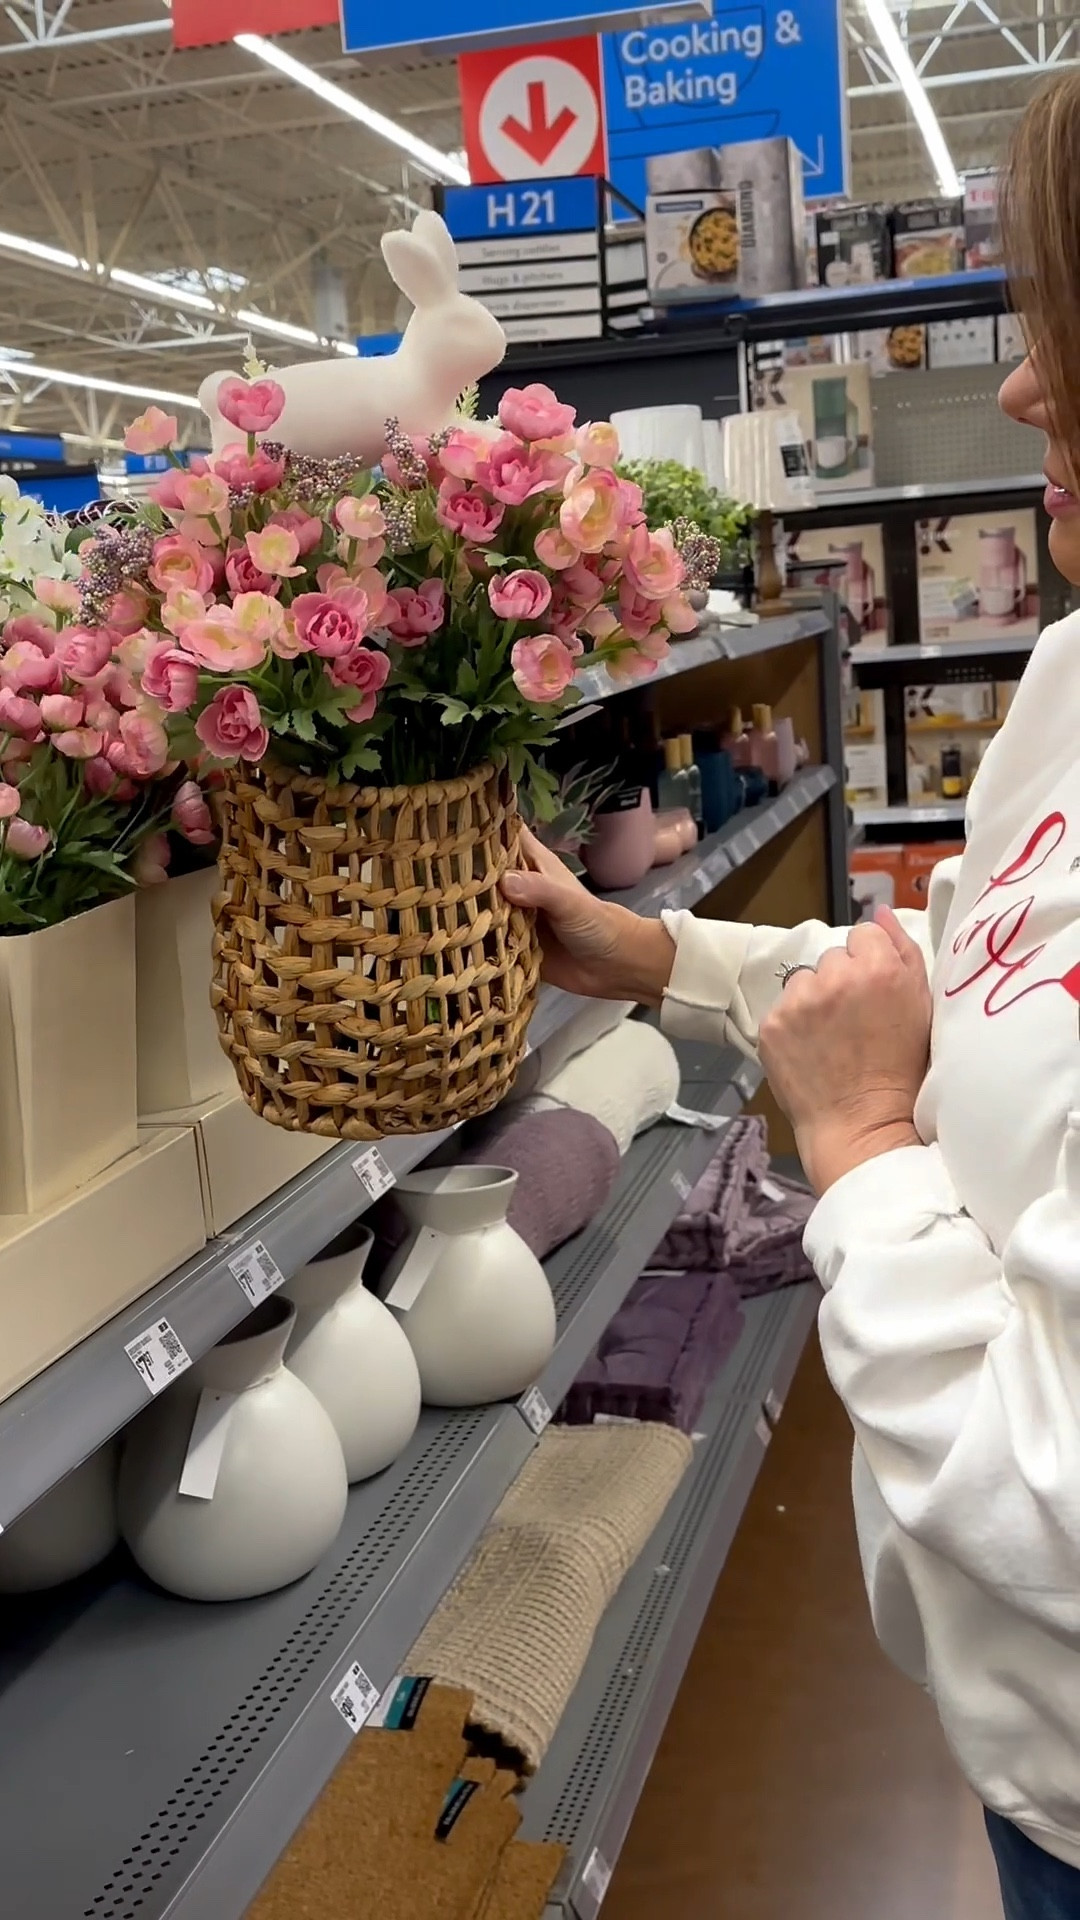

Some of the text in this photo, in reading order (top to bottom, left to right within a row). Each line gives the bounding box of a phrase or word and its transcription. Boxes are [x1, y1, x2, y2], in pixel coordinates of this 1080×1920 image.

[621, 9, 801, 65] Cooking &
[625, 68, 737, 108] Baking
